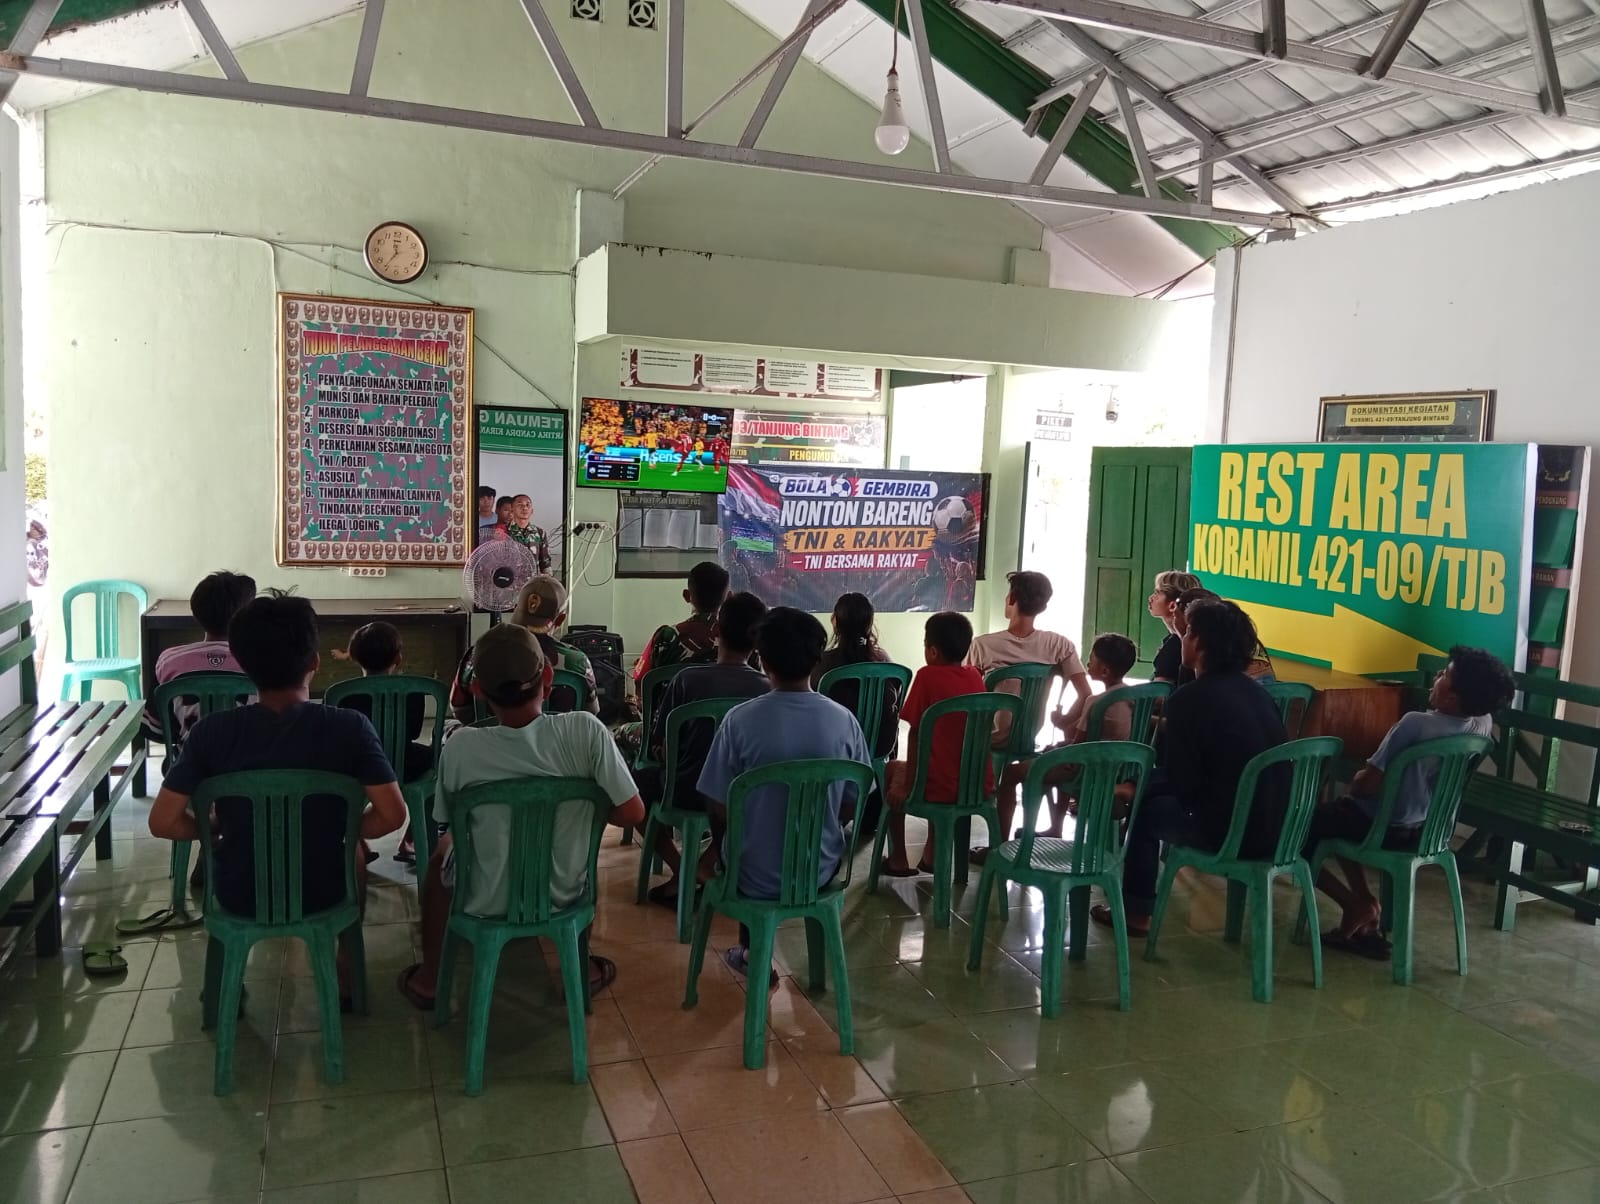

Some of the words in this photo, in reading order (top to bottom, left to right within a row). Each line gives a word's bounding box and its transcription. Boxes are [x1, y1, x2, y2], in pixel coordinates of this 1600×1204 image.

[303, 330, 339, 356] TUJUH
[340, 333, 416, 360] PELANGGARAN
[416, 339, 450, 368] BERAT
[304, 373, 311, 385] 1.
[318, 374, 396, 389] PENYALAHGUNAAN
[398, 378, 432, 391] SENJATA
[318, 391, 351, 403] MUNISI
[353, 393, 370, 404] DAN
[372, 394, 401, 406] BAHAN
[402, 395, 438, 408] PELEDAK
[304, 406, 312, 418] 2.
[318, 407, 360, 419] NARKOBA
[1351, 406, 1407, 416] DOKUMENTASI
[1409, 404, 1449, 414] KEGIATAN
[304, 423, 313, 434] 3.
[318, 423, 354, 435] DESERSI
[356, 425, 374, 437] DAN
[376, 426, 437, 439] ISUBORDINASI
[802, 423, 849, 440] BINTANG
[304, 438, 312, 449] 4.
[318, 439, 376, 452] PERKELAHIAN
[378, 442, 412, 454] SESAMA
[414, 443, 452, 455] ANGGOTA
[318, 455, 333, 467] TNI
[335, 456, 340, 467] /
[341, 456, 366, 467] POLRI
[305, 471, 313, 482] 5.
[318, 471, 356, 483] ASUSILA
[305, 487, 313, 498] 6.
[319, 487, 363, 499] TINDAKAN
[364, 489, 405, 501] KRIMINAL
[407, 490, 441, 502] LAINNYA
[784, 479, 827, 494] BOLA
[863, 481, 931, 497] GEMBIRA
[1217, 451, 1325, 527] REST
[1329, 452, 1467, 539] AREA
[305, 503, 312, 514] 7.
[319, 503, 363, 515] TINDAKAN
[364, 504, 402, 516] BECKING
[403, 505, 420, 516] DAN
[780, 500, 859, 527] NONTON
[861, 501, 934, 526] BARENG
[319, 519, 349, 530] ILEGAL
[350, 519, 380, 531] LOGING
[793, 531, 829, 550] TNI
[833, 533, 846, 549] &
[853, 530, 928, 549] RAKYAT
[804, 555, 822, 569] TNI
[824, 554, 874, 569] BERSAMA
[876, 553, 918, 569] RAKYAT
[1193, 523, 1302, 587] KORAMIL
[1309, 535, 1506, 615] 421-09/TJB
